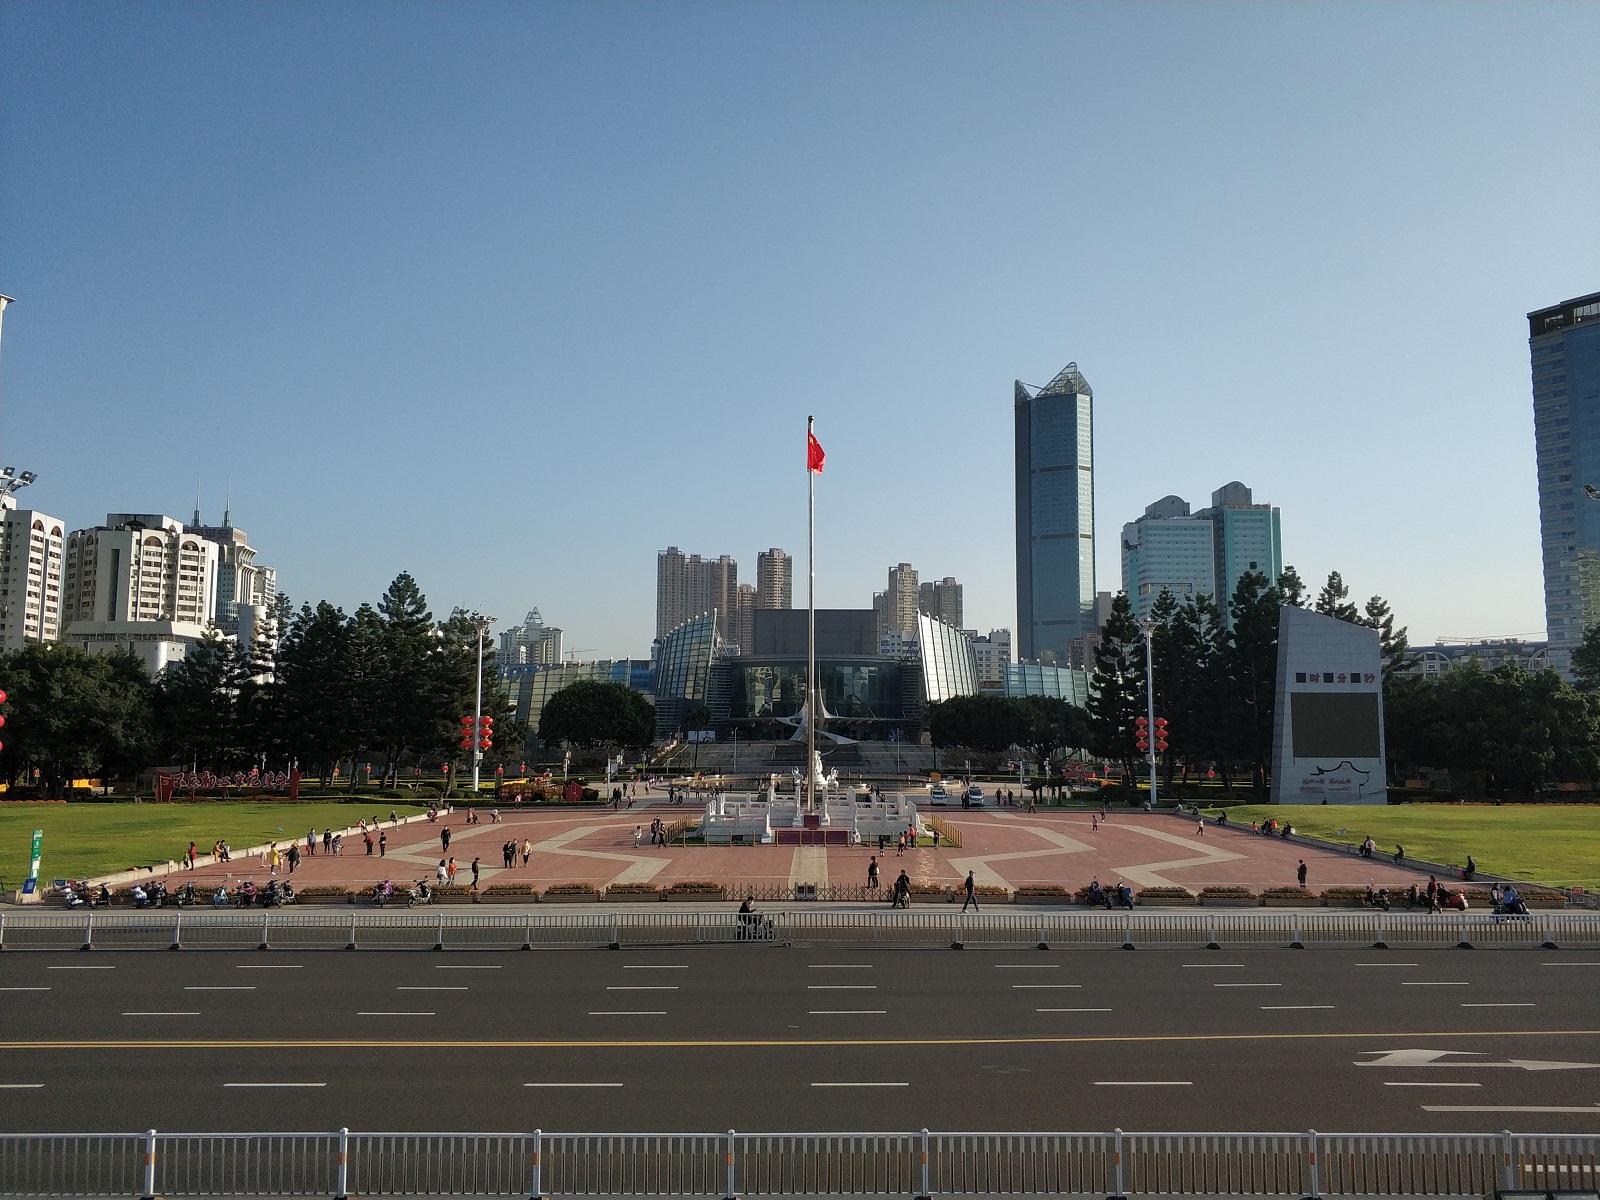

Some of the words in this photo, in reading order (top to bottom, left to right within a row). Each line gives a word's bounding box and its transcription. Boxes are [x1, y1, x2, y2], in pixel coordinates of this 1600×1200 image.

[1309, 673, 1320, 683] 时
[1337, 673, 1347, 683] 分
[1364, 673, 1375, 683] 秒
